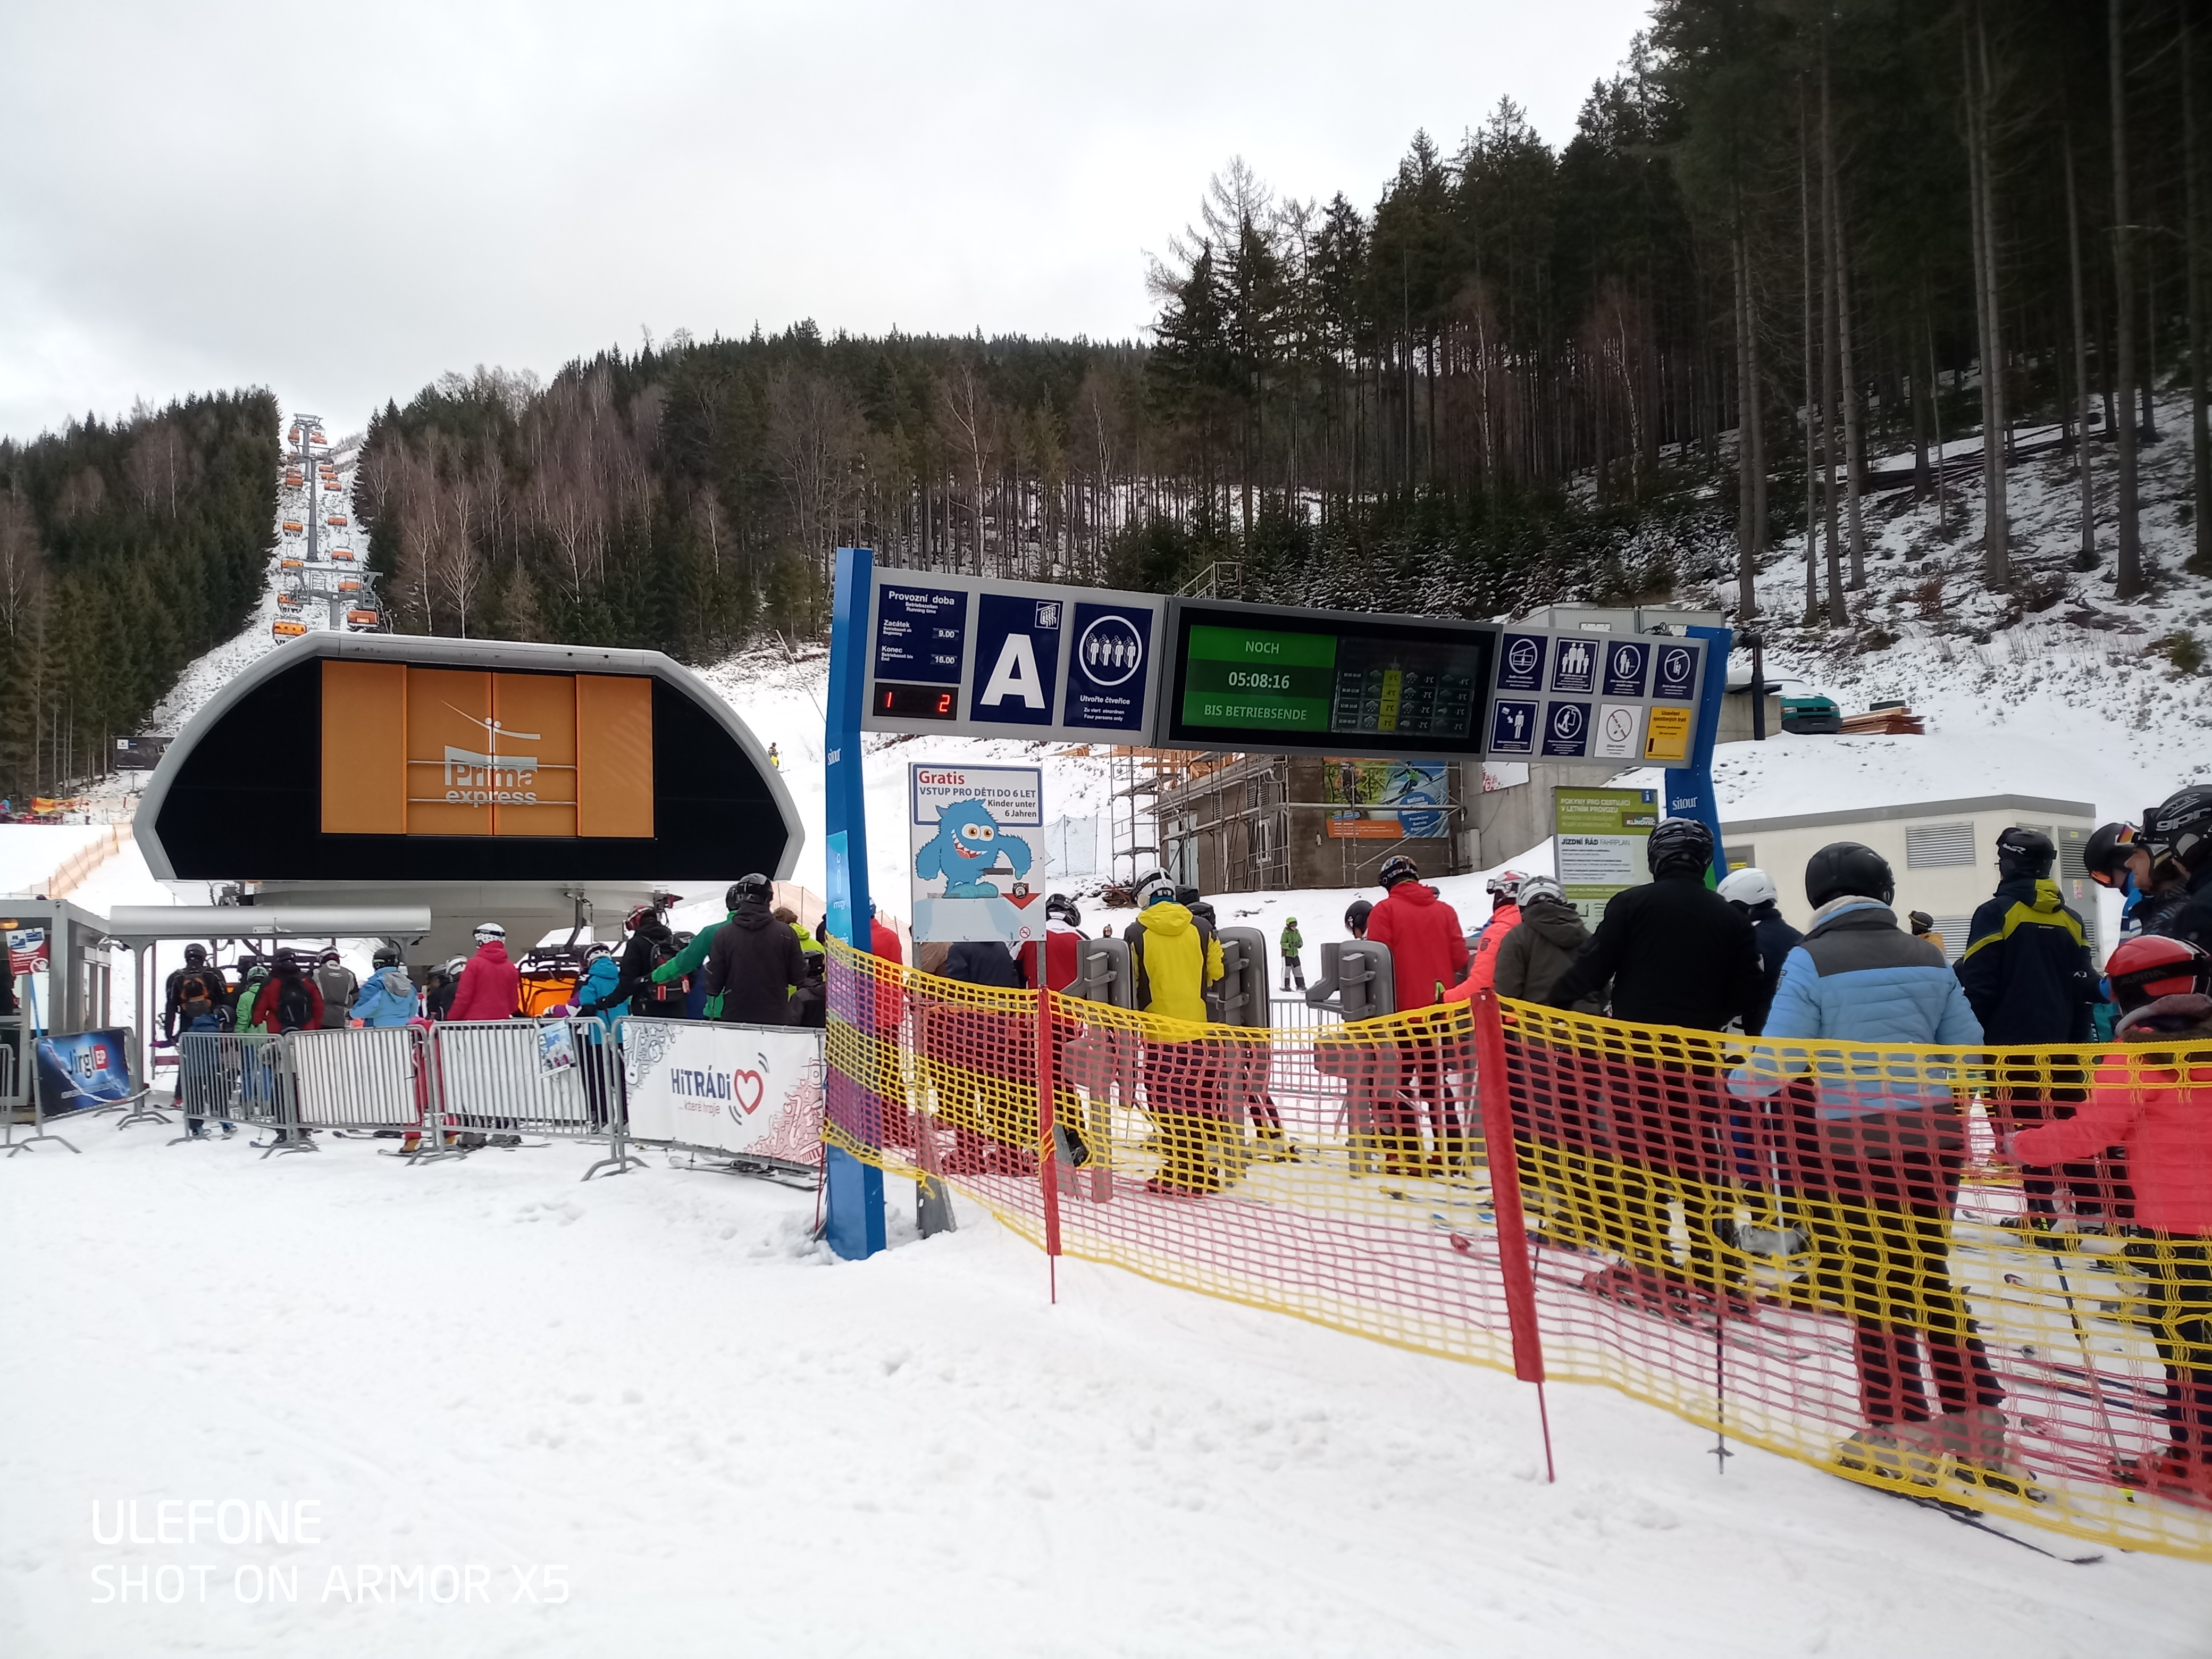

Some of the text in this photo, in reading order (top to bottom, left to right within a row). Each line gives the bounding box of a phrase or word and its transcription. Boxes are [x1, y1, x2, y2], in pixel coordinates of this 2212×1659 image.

[889, 591, 955, 605] Provozní doba
[938, 630, 955, 638] 9.00
[882, 645, 903, 653] Konec
[1245, 641, 1280, 654] NOCH
[935, 656, 955, 664] 16.00
[980, 633, 1045, 709] A
[1228, 672, 1290, 689] 05:08:16
[939, 694, 950, 712] 2
[1105, 696, 1130, 705] čtveřice
[1204, 705, 1307, 720] BIS BETRIEBSENDE
[450, 759, 537, 787] Prima
[919, 770, 965, 785] Gratis
[446, 790, 537, 808] express
[919, 787, 950, 795] VSTUP
[953, 788, 972, 797] PRO
[974, 787, 995, 797] DĚTI
[1020, 790, 1036, 798] LET
[1672, 796, 1699, 811] sitour
[2156, 807, 2212, 832] gpr
[1562, 837, 1583, 846] JÍZDNÍ
[1585, 837, 1599, 846] ŘÁD
[2121, 970, 2168, 985] ALPINA
[2090, 1023, 2099, 1042] LEKI
[67, 1046, 96, 1079] Jirgl
